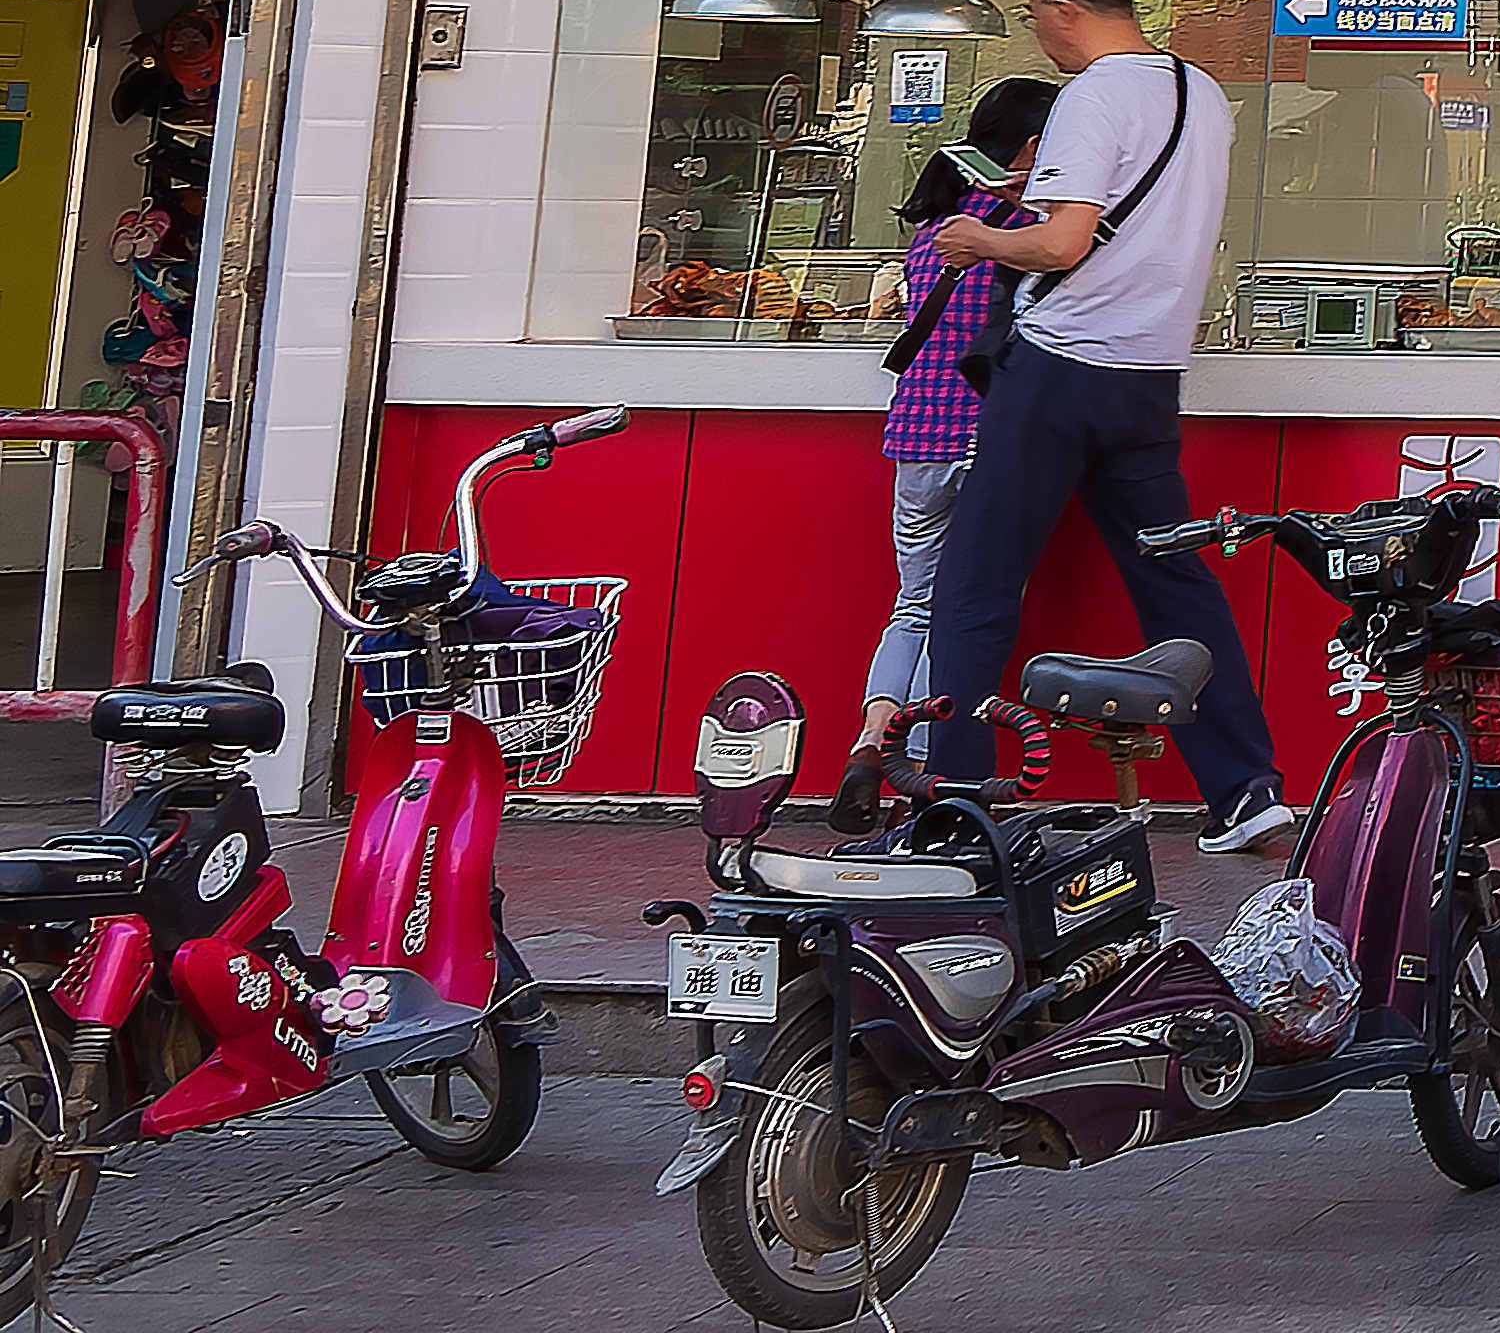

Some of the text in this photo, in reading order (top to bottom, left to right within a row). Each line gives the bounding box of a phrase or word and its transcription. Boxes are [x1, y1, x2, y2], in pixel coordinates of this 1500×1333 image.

[1336, 11, 1457, 32] 钱钞当面点清
